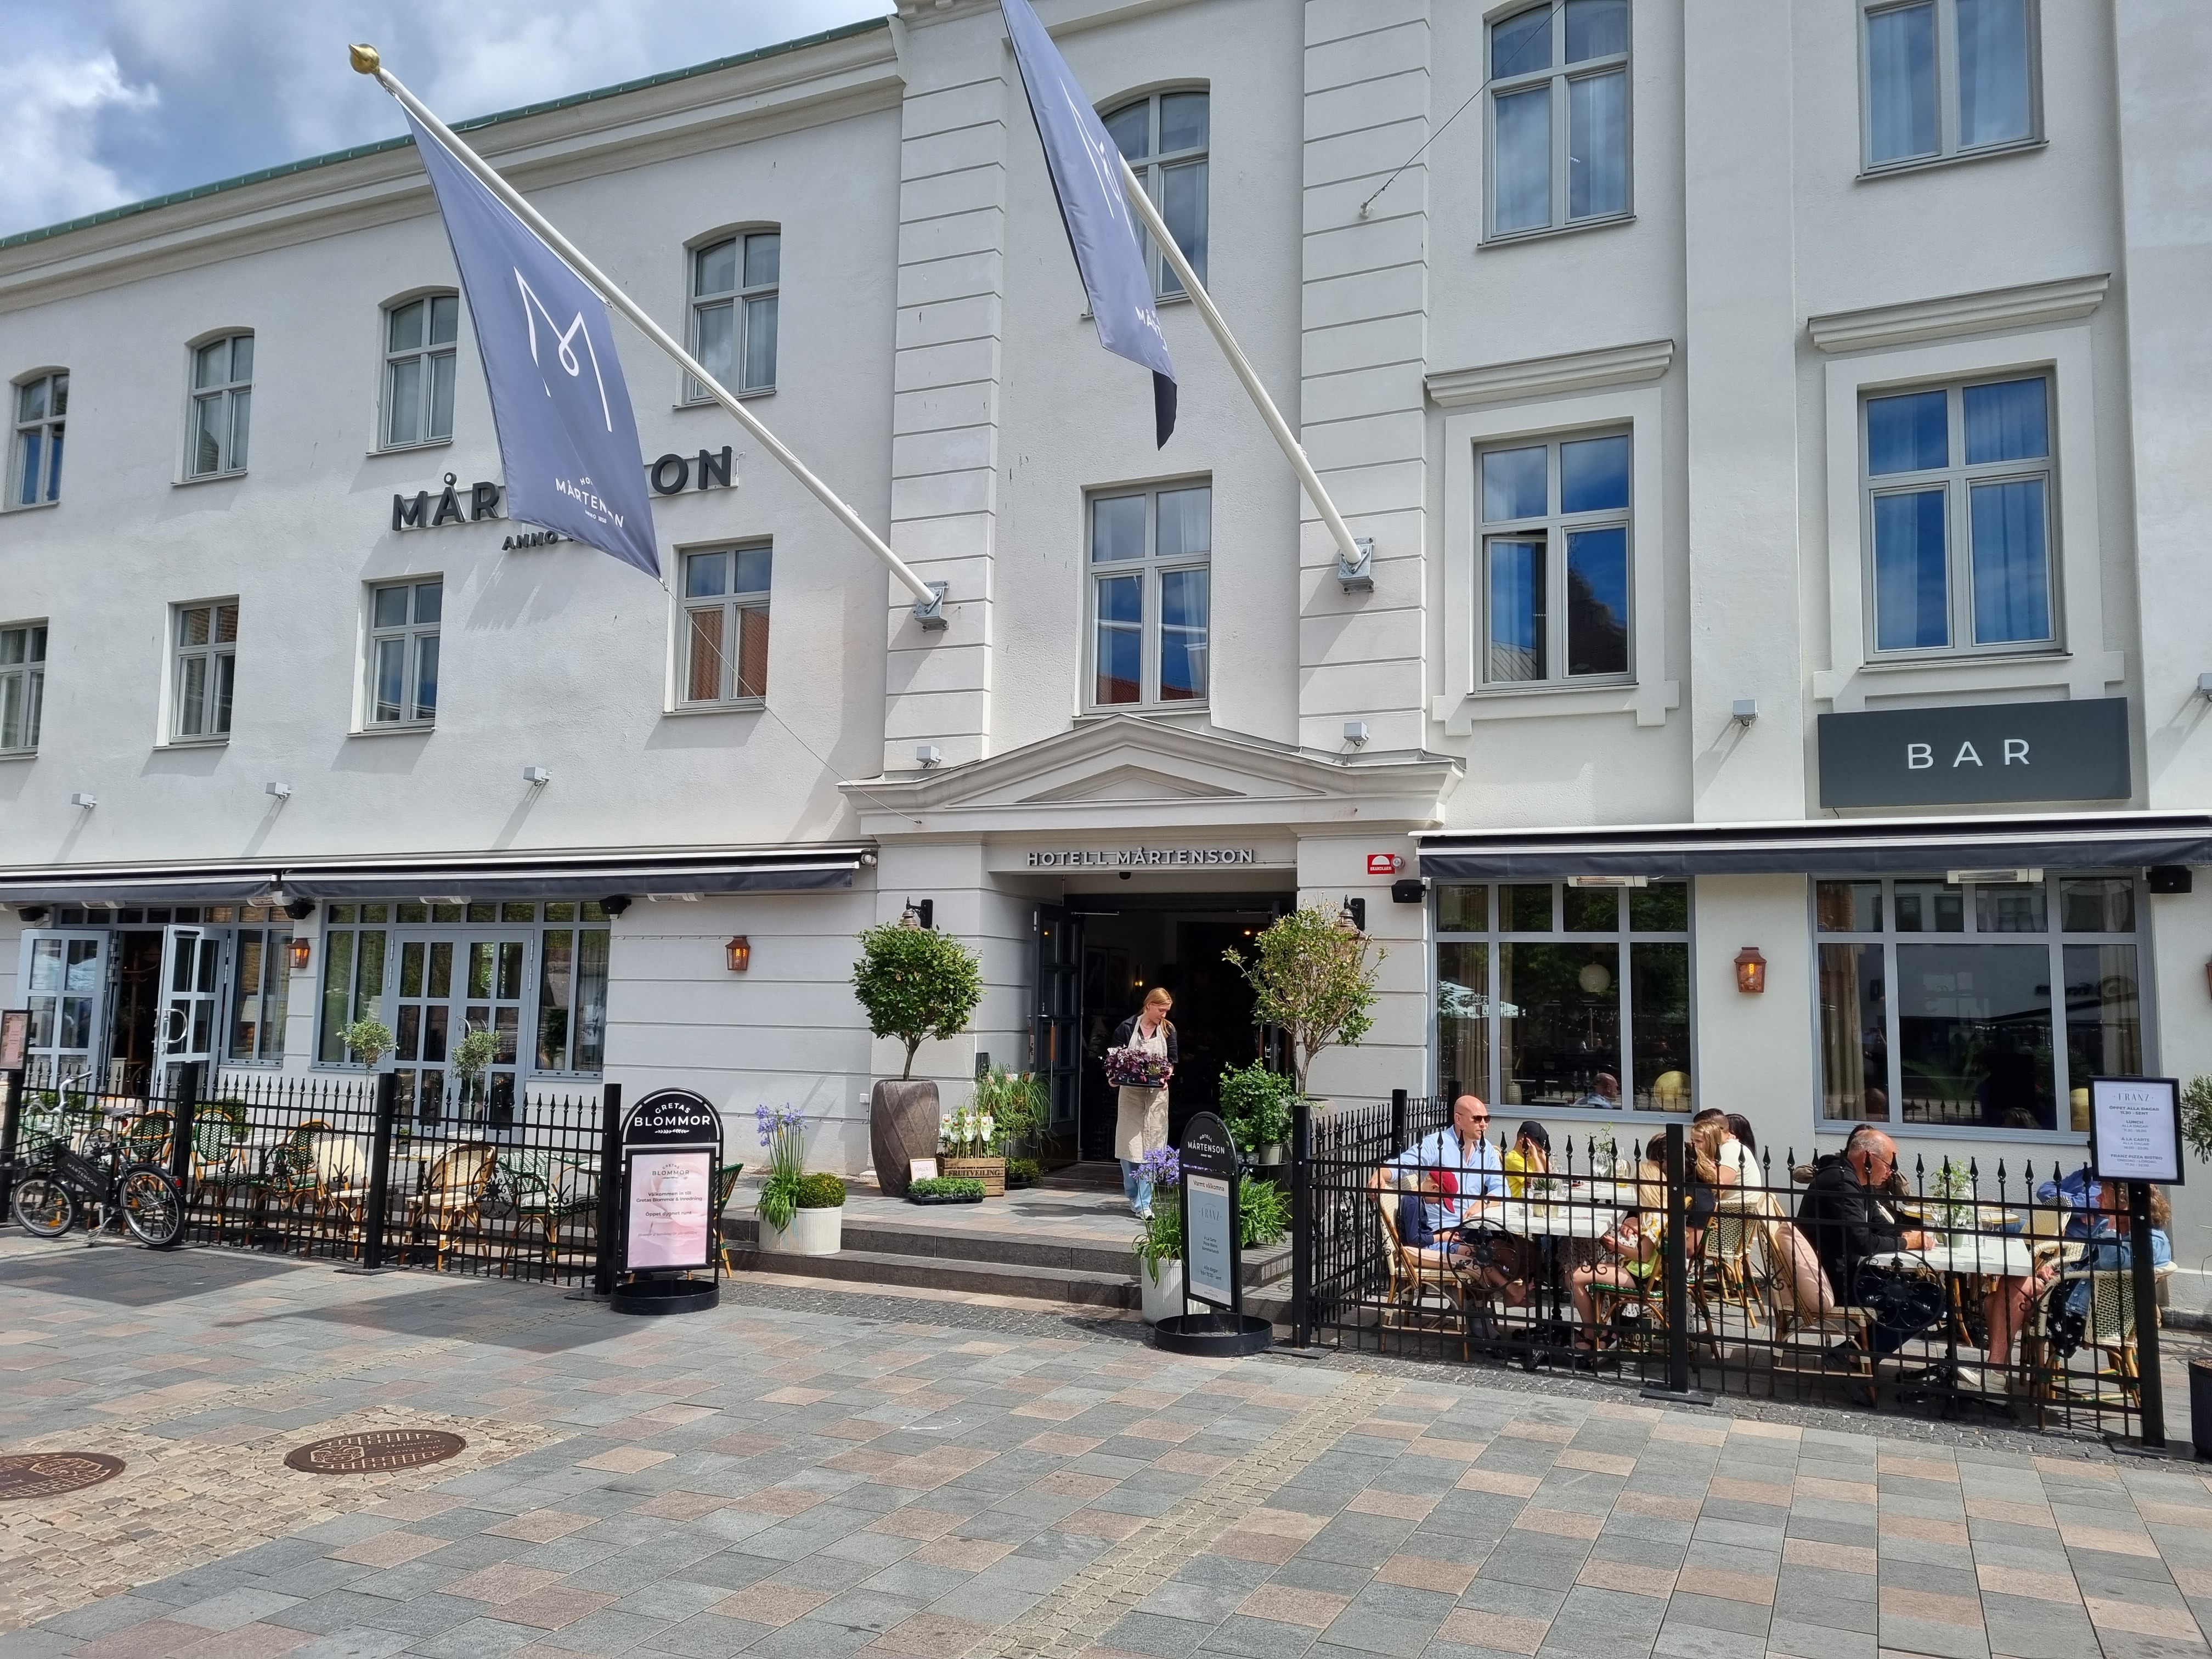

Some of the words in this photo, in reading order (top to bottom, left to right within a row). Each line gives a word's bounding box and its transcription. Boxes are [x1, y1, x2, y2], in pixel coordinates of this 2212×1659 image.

[501, 530, 558, 551] ANNO
[1907, 739, 2030, 769] BAR
[1026, 851, 1109, 866] HOTELL
[1116, 847, 1255, 865] MÅRTENSON
[2118, 1093, 2149, 1102] FRANZ
[655, 1103, 691, 1114] GRETAS
[634, 1116, 710, 1126] BLOMMOR
[1199, 1134, 1212, 1142] HOTELL
[1188, 1139, 1225, 1154] MÅRTENSON
[1193, 1180, 1205, 1188] Varmt
[1205, 1182, 1224, 1192] välkomna
[1201, 1207, 1219, 1221] FRANZ
